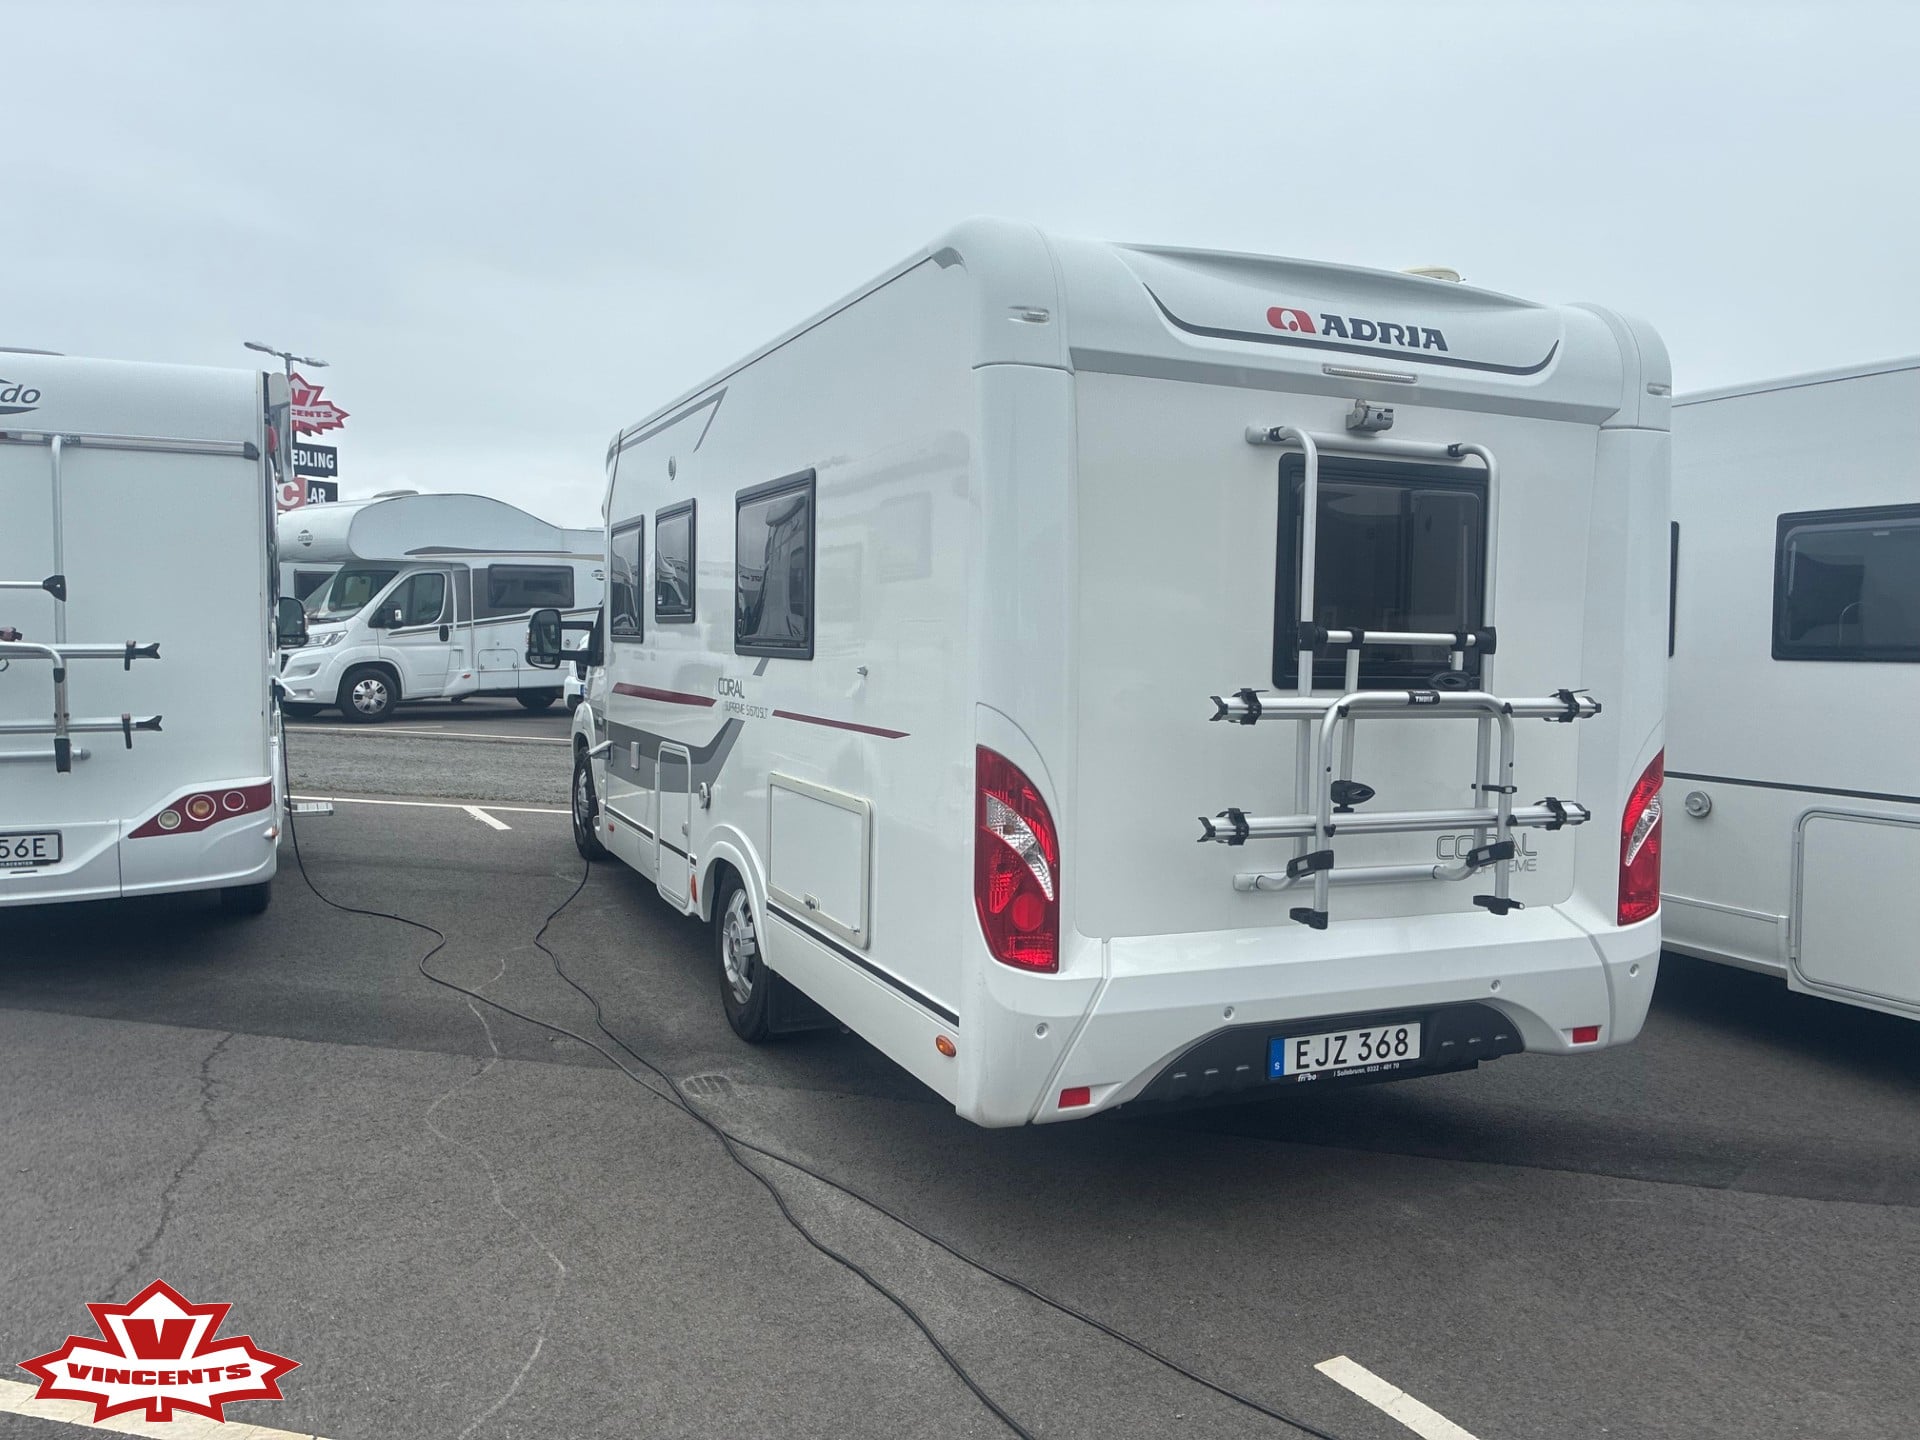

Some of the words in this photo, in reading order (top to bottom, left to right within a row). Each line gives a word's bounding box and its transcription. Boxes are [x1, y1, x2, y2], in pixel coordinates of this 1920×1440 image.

[1320, 313, 1448, 351] ADRIA
[292, 449, 334, 469] EDLING
[307, 487, 326, 503] AR
[718, 677, 745, 699] CORAL
[0, 837, 46, 858] 56E
[1437, 832, 1537, 860] COL
[1296, 1035, 1348, 1070] EJZ
[1358, 1028, 1409, 1061] 368
[1274, 1061, 1281, 1070] S
